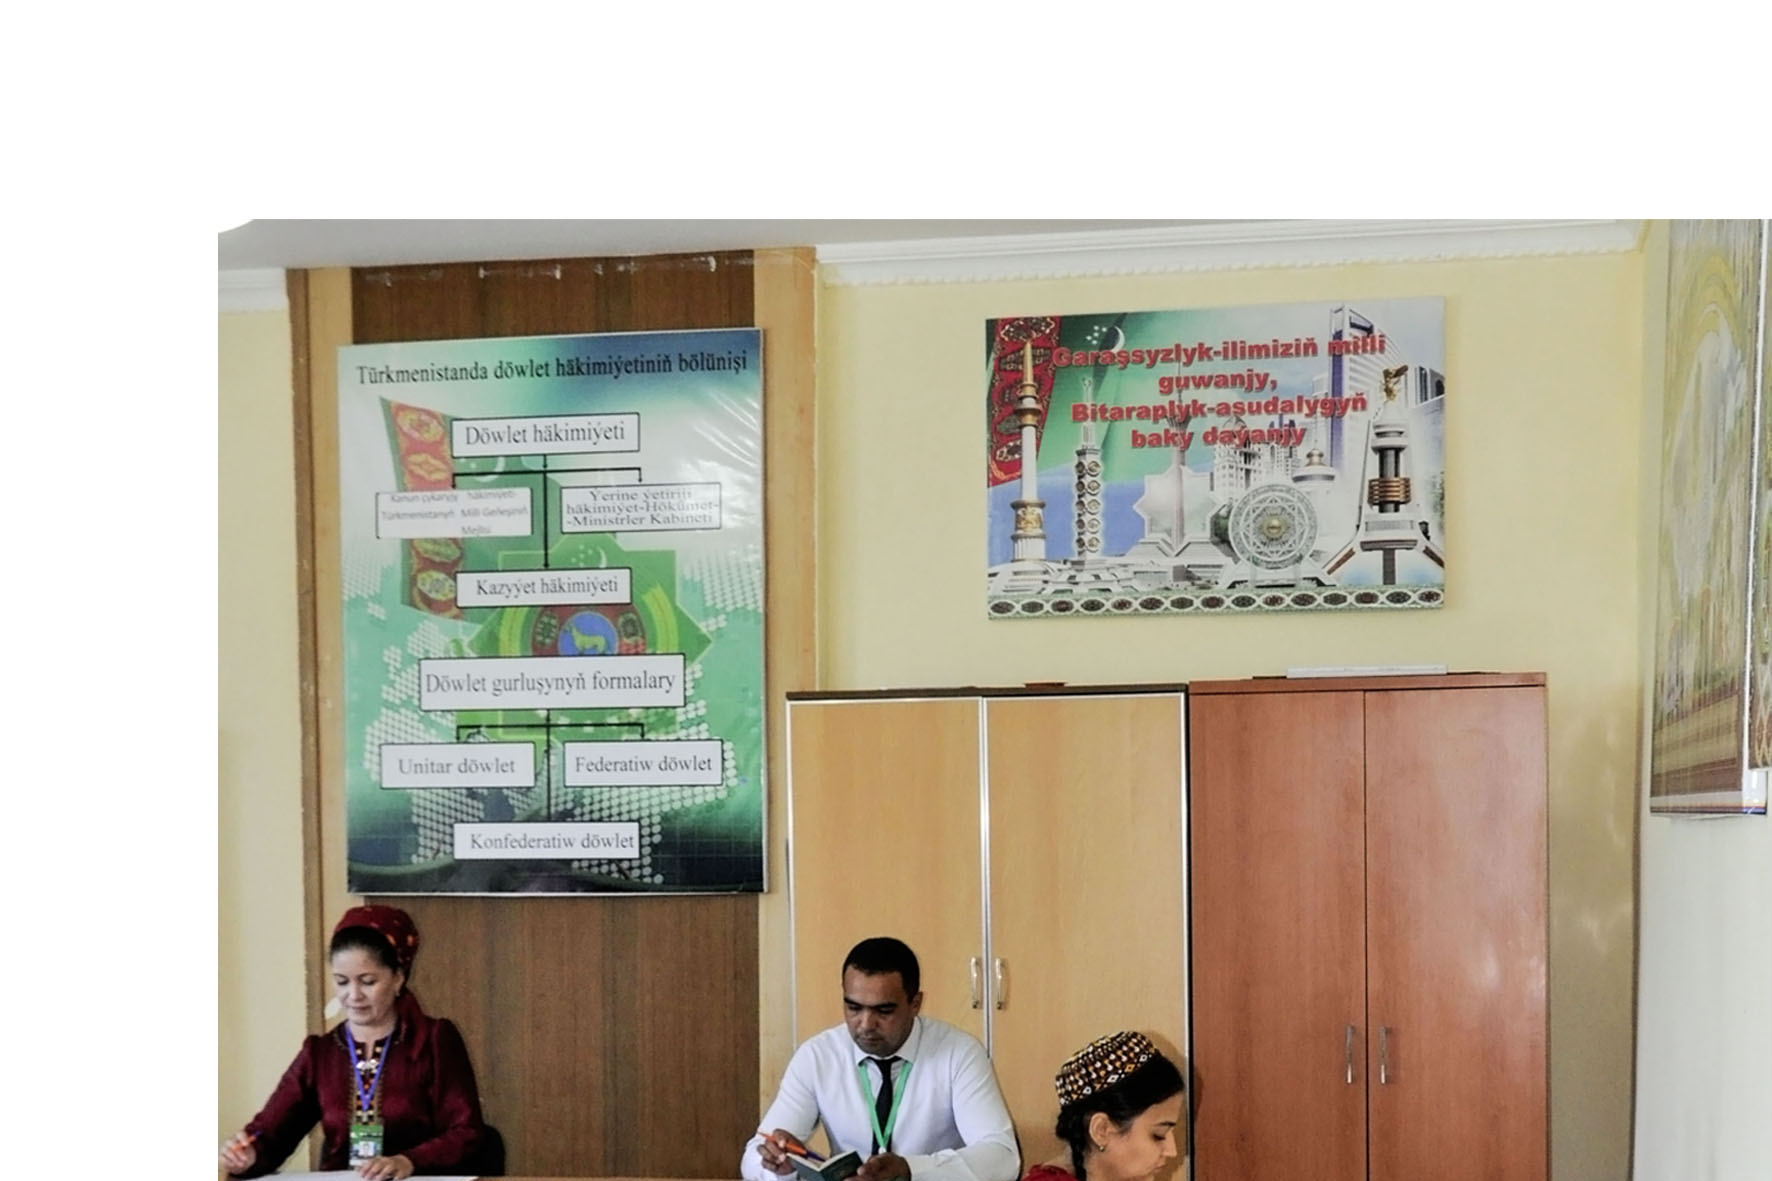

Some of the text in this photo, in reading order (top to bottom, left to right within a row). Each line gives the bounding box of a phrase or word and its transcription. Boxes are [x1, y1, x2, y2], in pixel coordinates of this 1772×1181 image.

[1051, 334, 1386, 370] Garaşsyzlyk-ilimiziň milli
[356, 361, 488, 385] Türkmenistanda
[493, 358, 550, 380] döwlet
[678, 350, 747, 375] bölünişi
[1158, 369, 1277, 395] guwanjy,
[1072, 393, 1367, 424] Bitaraplyk-asudalygyň
[465, 420, 625, 446] Döwlet häkimiýeti
[1131, 424, 1307, 450] baky daýanjy
[476, 575, 618, 599] Kazyýet häkimiýeti
[425, 670, 675, 697] Döwlet gurluşynyň formalary
[398, 756, 515, 775] Unitar döwlet
[575, 753, 712, 773] Federatiw döwlet
[470, 829, 635, 850] Konfederatiw döwlet
